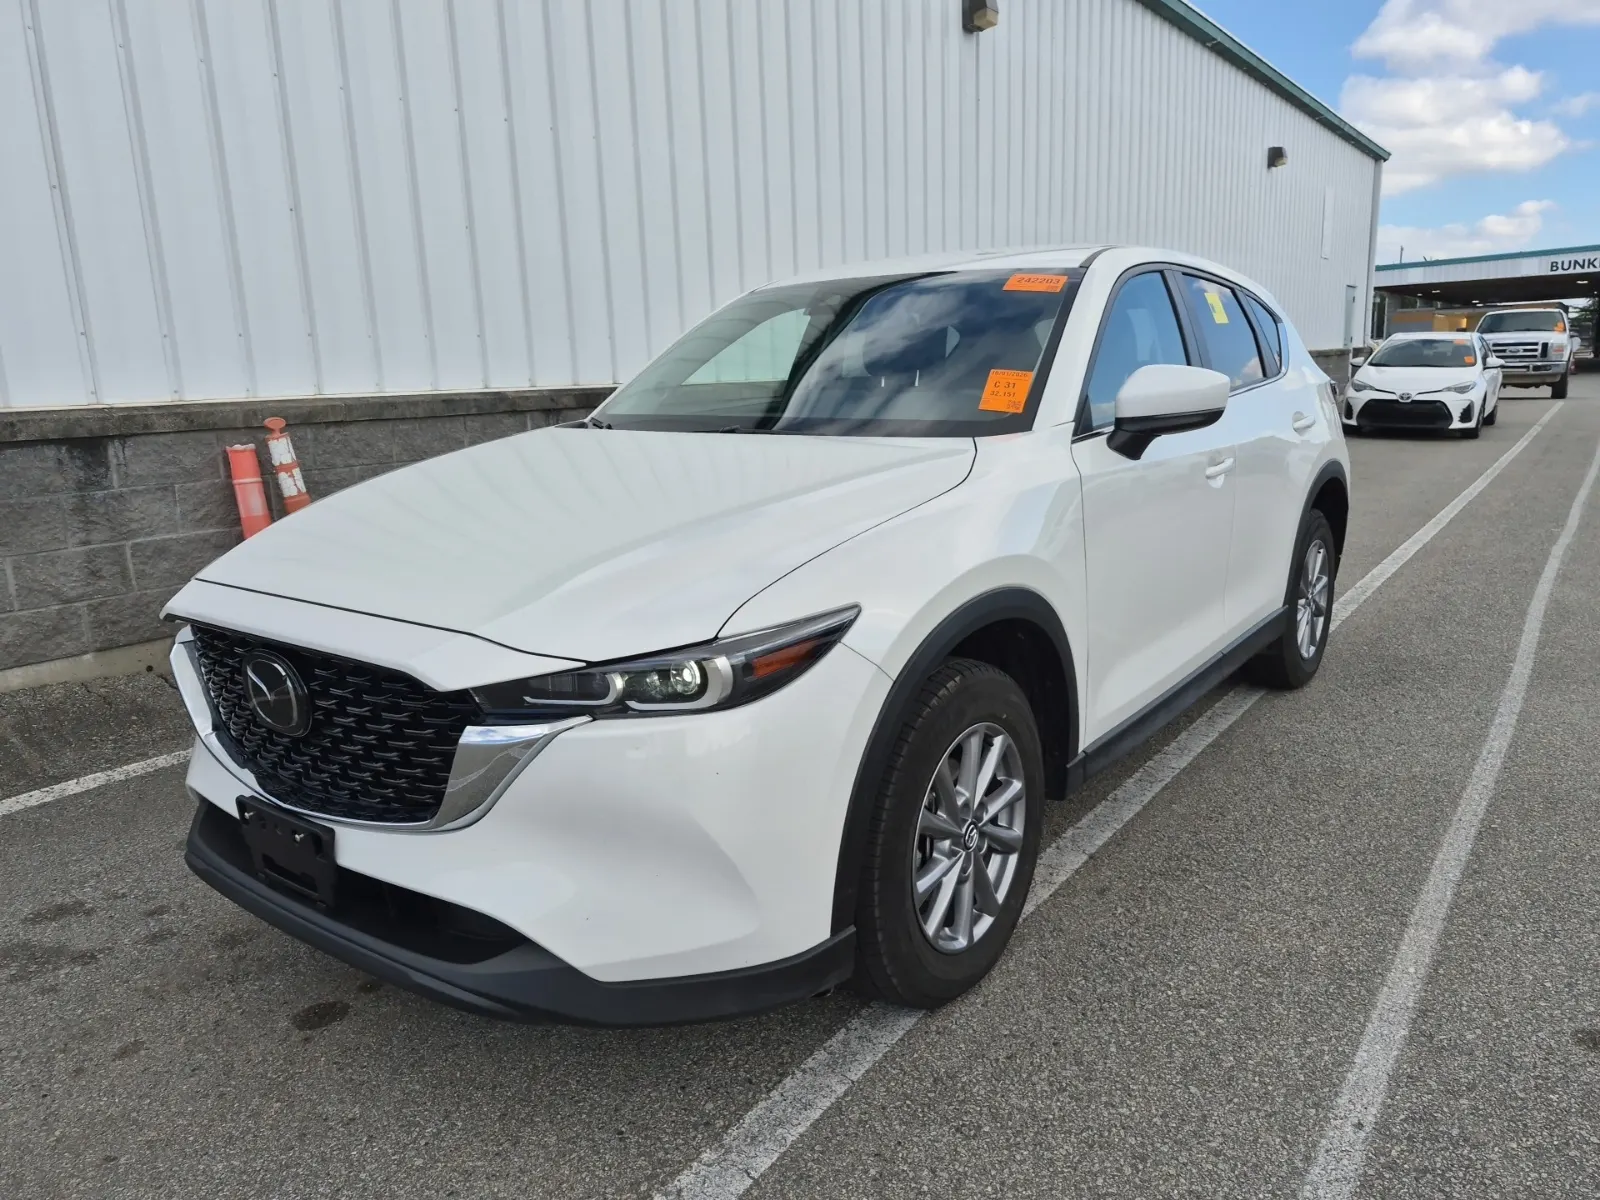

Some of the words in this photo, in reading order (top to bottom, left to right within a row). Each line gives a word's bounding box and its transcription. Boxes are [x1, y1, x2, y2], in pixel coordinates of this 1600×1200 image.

[1550, 257, 1600, 272] BUNK
[1016, 277, 1061, 285] 242203
[993, 380, 1001, 388] C
[1003, 381, 1016, 389] 31
